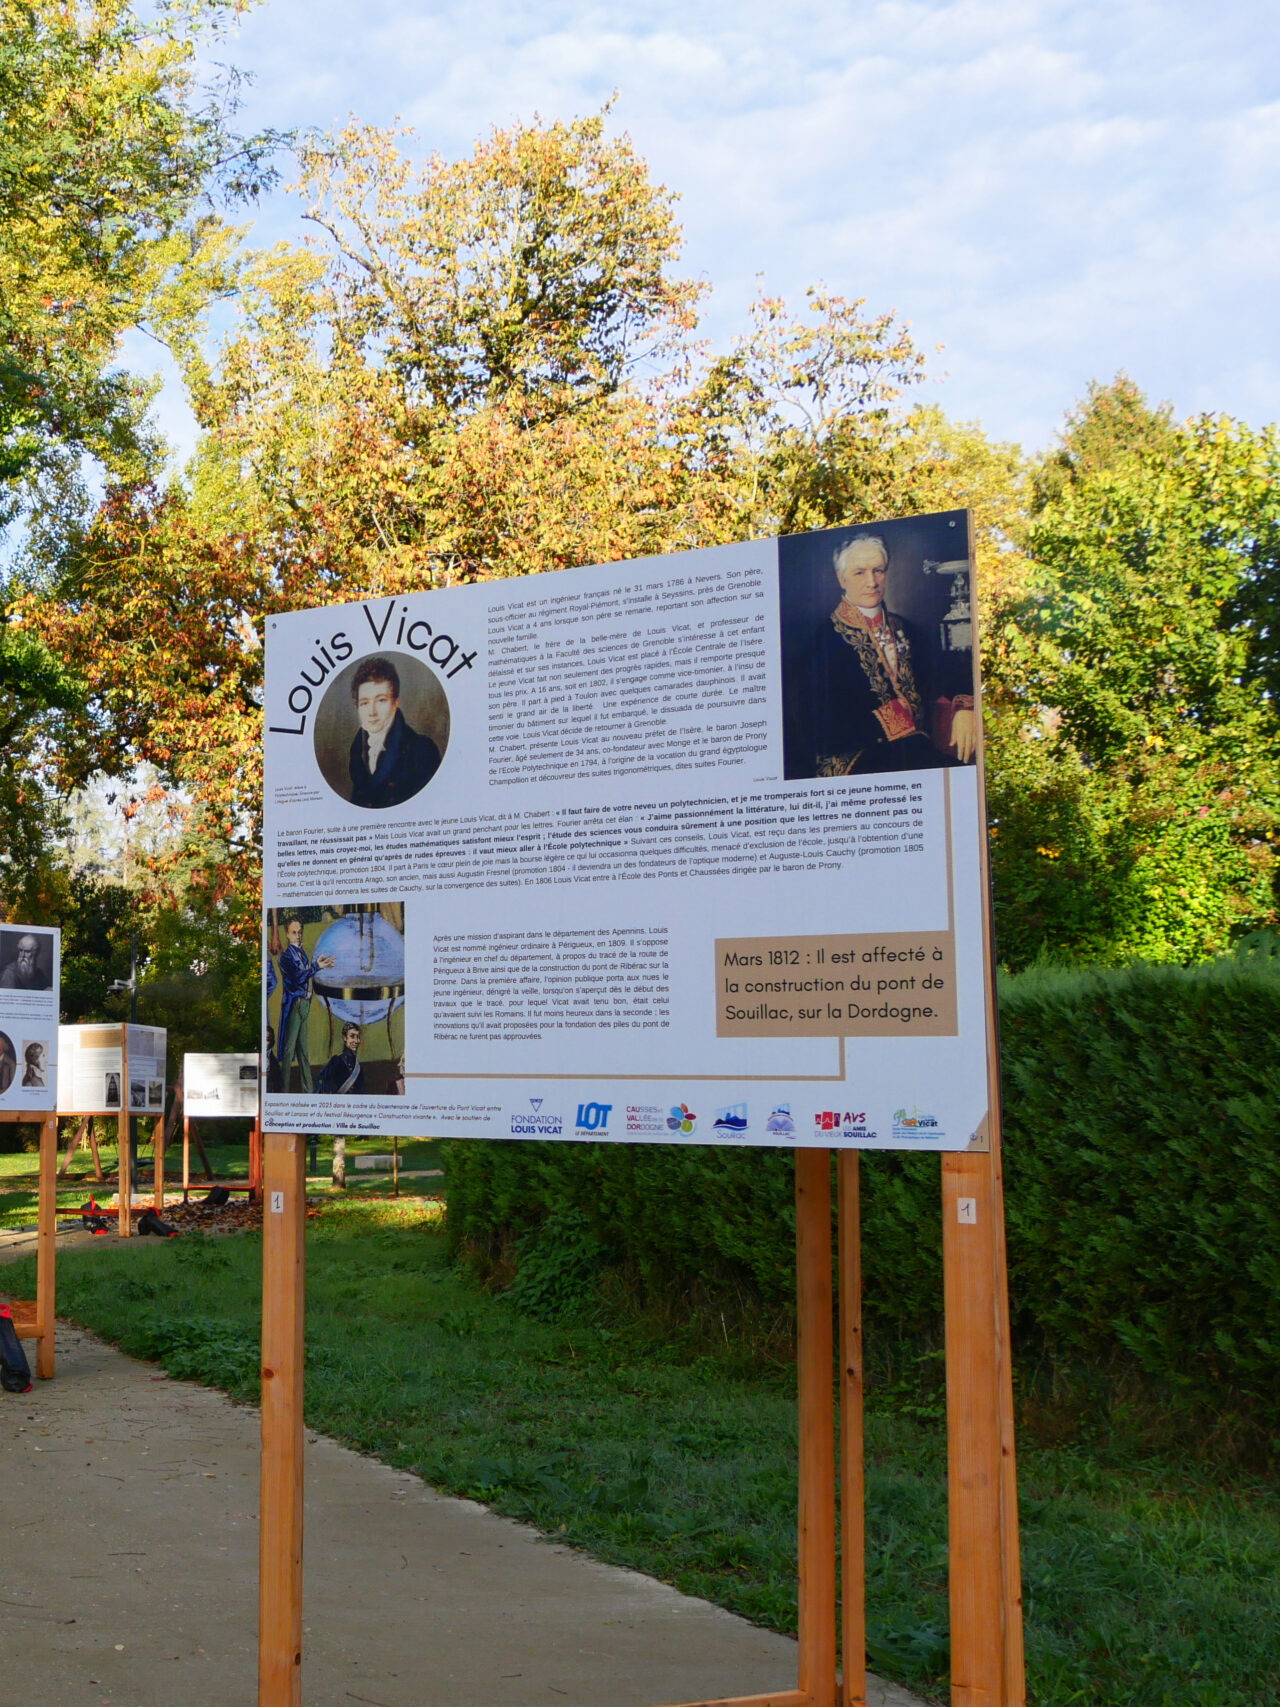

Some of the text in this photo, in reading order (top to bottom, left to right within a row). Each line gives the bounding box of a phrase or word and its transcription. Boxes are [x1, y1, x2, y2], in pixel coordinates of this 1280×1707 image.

[507, 601, 523, 610] Vicat
[550, 594, 580, 604] ingénieur
[583, 590, 610, 598] français
[667, 578, 684, 587] 1786
[695, 574, 722, 582] Nevers.
[744, 568, 763, 577] père,
[269, 600, 478, 735] Louis Vicat
[499, 744, 526, 752] Chabert,
[529, 741, 558, 750] présente
[560, 738, 579, 746] Louis
[644, 729, 665, 739] préfet
[739, 720, 767, 728] Joseph
[336, 845, 372, 853] croyez-moi,
[409, 839, 459, 847] mathématiques
[516, 833, 540, 841] l'esprit
[681, 821, 717, 829] sûrement
[744, 817, 777, 826] position
[779, 816, 794, 824] que
[854, 809, 890, 818] donnent
[892, 808, 908, 817] pas
[724, 946, 942, 966] Mars 1812 : Il est affecté à
[725, 974, 944, 994] la construction du pont de
[725, 1003, 937, 1022] Souillac, sur la Dordogne.
[264, 1119, 294, 1128] Conception
[512, 1114, 562, 1124] FONDATION
[576, 1102, 612, 1130] LOT
[843, 1112, 866, 1124] AVS
[538, 1126, 562, 1134] VICAT
[717, 1131, 745, 1139] Souillac
[274, 1194, 280, 1209] 1
[961, 1203, 969, 1216] 1
